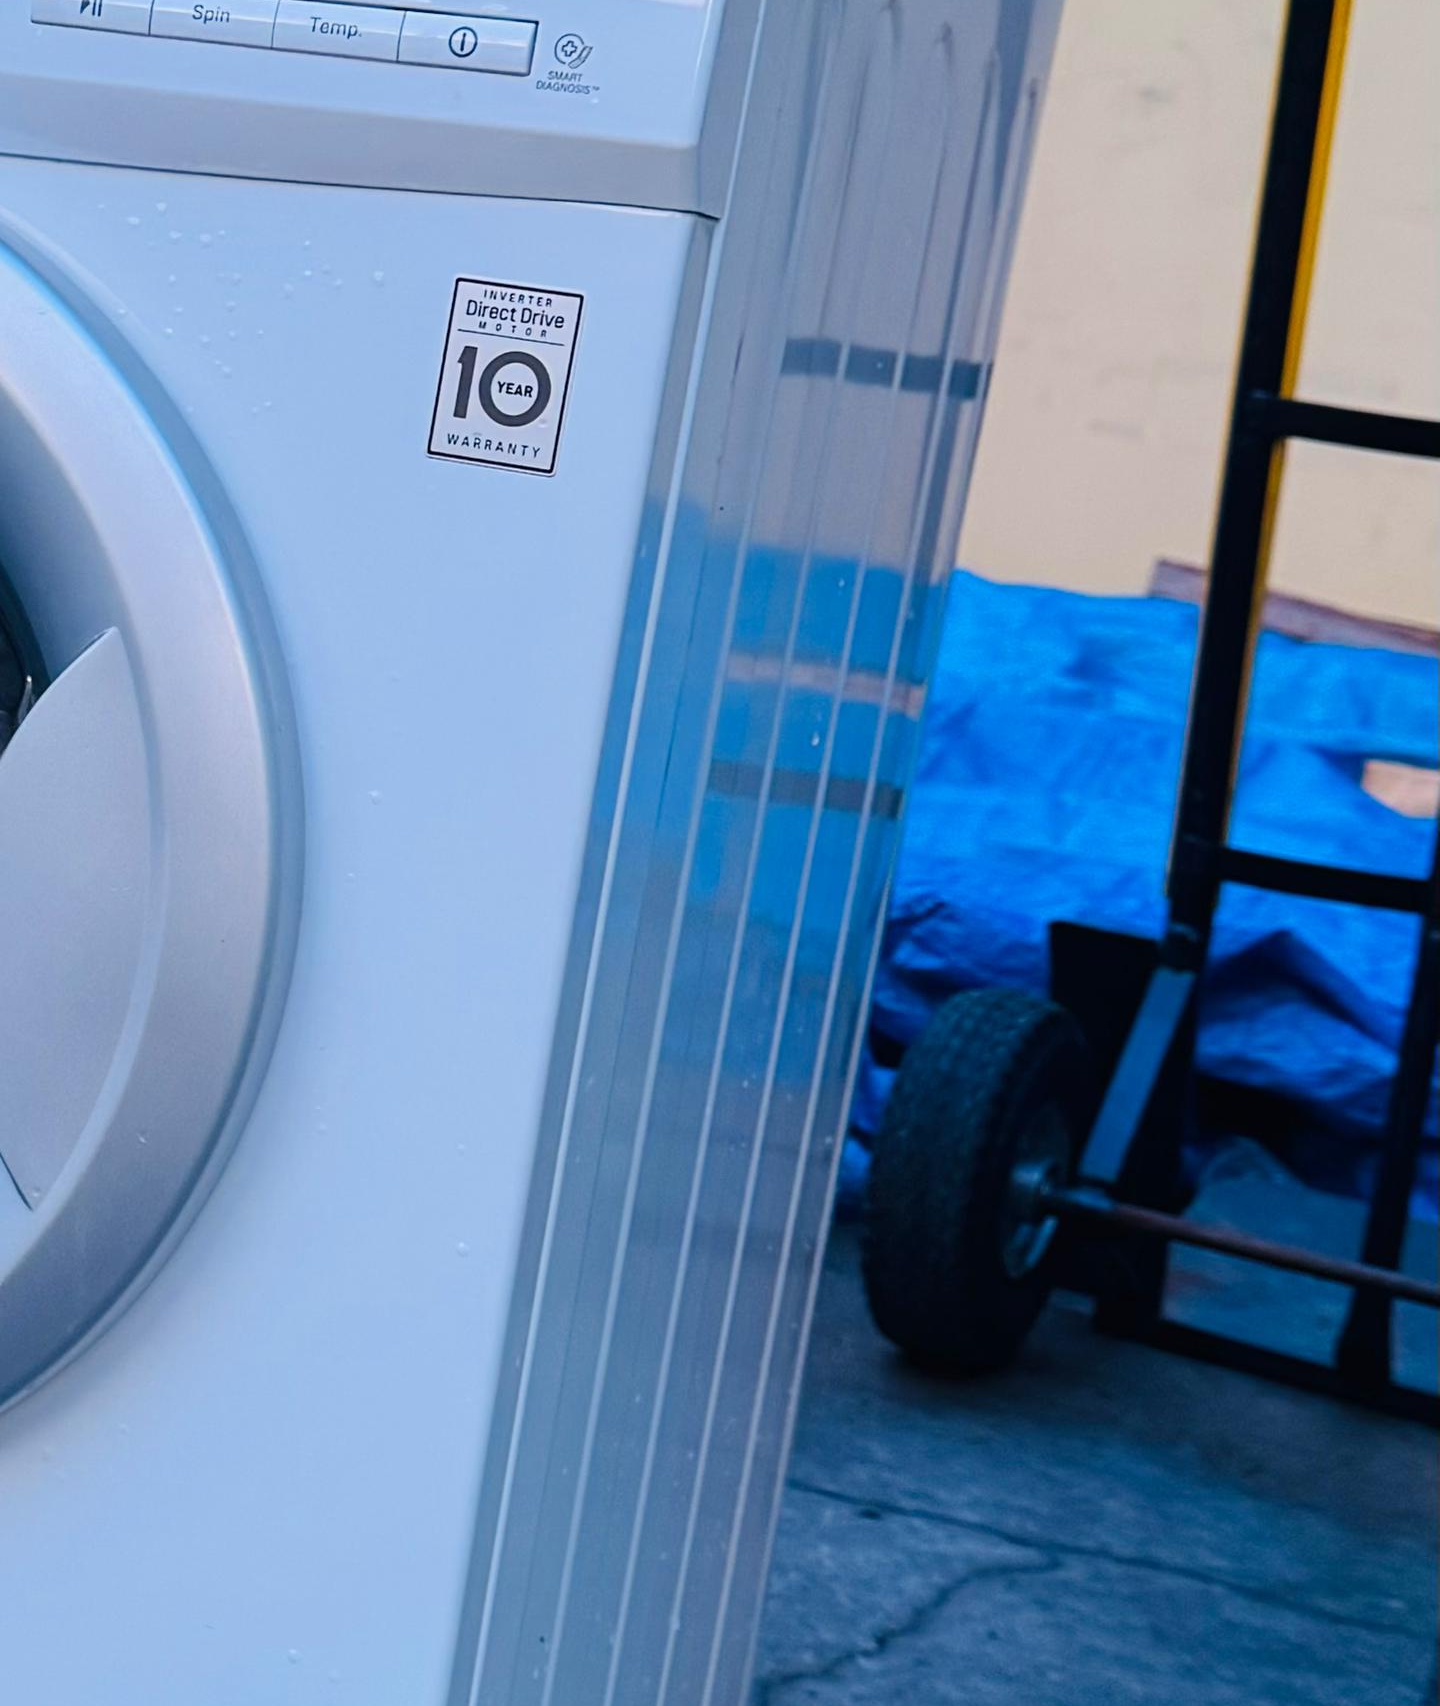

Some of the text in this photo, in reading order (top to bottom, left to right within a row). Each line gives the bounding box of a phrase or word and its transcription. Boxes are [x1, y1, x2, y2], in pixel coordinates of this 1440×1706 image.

[192, 4, 231, 24] Spin
[309, 16, 363, 40] Temp.
[547, 70, 583, 83] SMART
[483, 289, 553, 308] INVERTER
[466, 299, 565, 329] Direct Drive
[478, 321, 548, 338] MOTOR
[453, 345, 552, 428] 10
[497, 380, 534, 398] YEAR
[446, 433, 541, 458] WARRANTY
